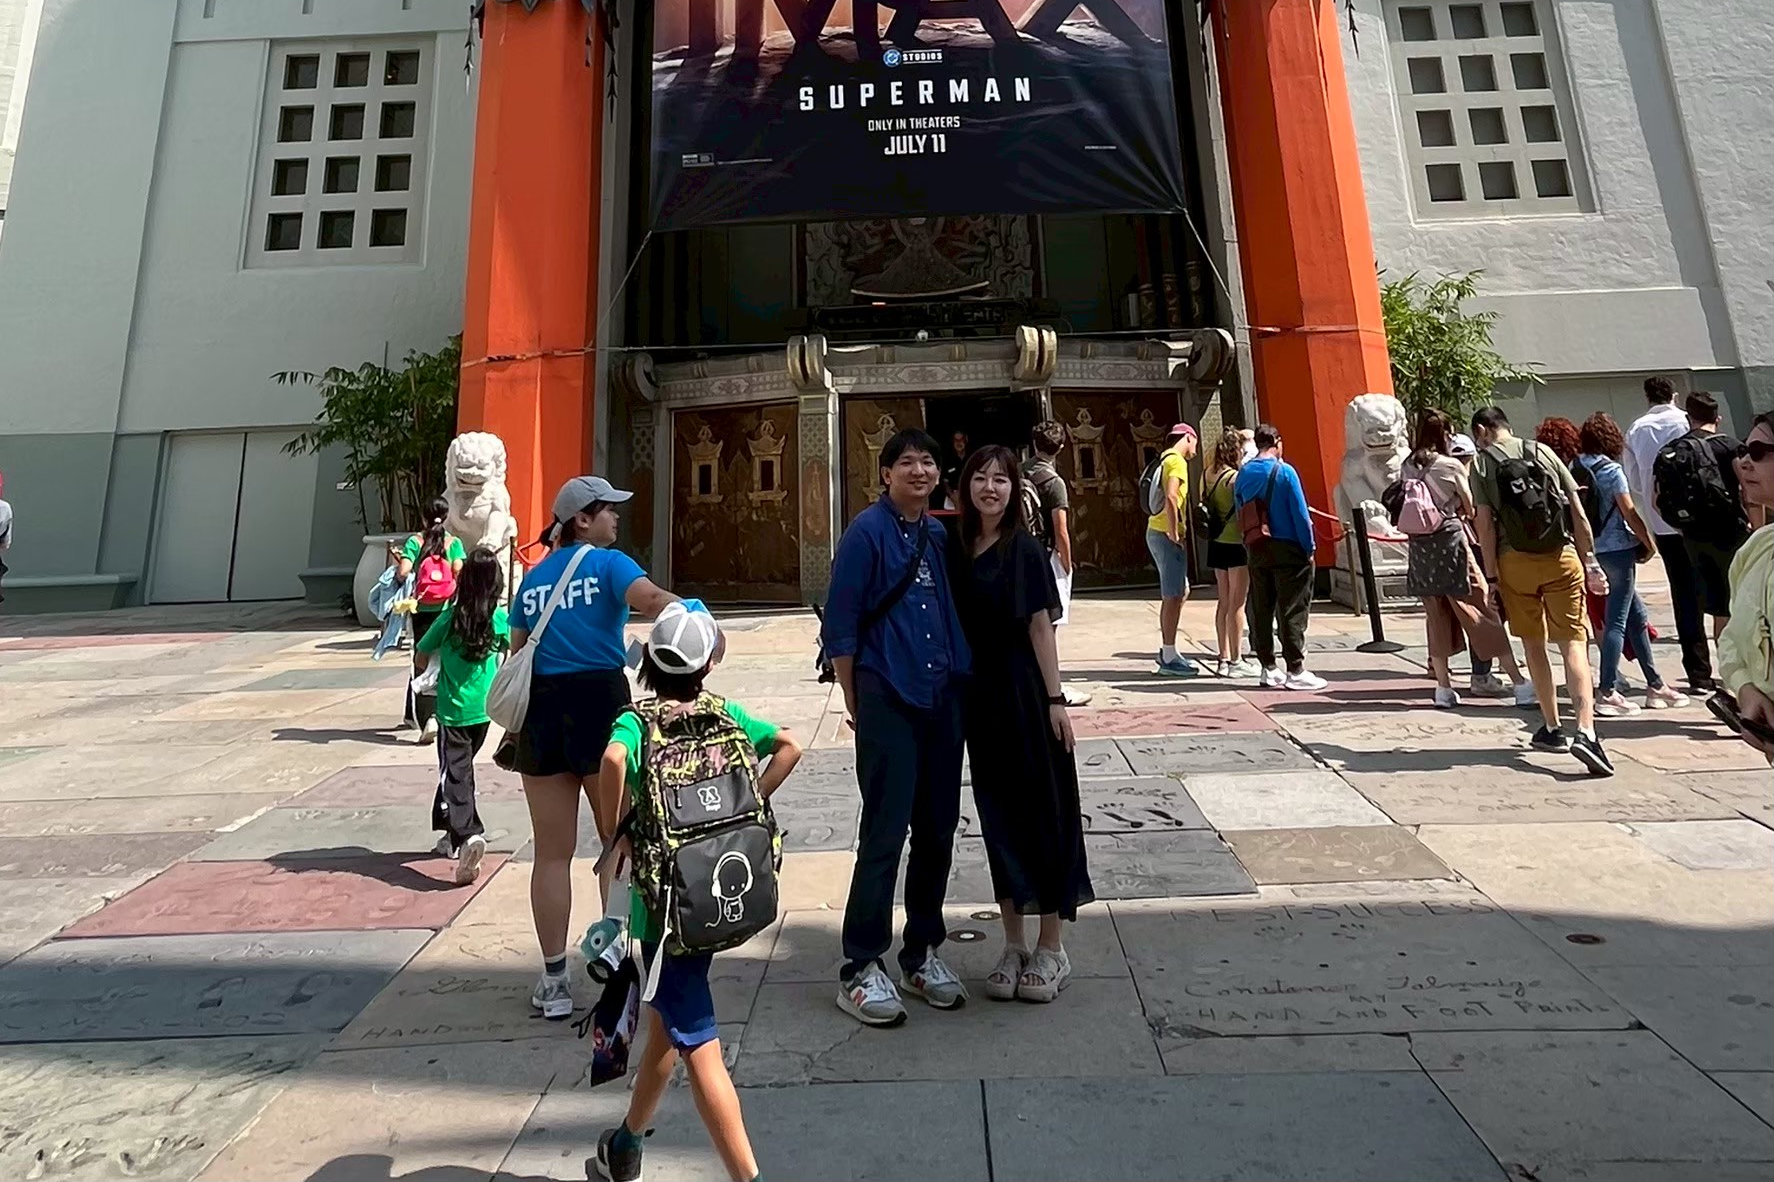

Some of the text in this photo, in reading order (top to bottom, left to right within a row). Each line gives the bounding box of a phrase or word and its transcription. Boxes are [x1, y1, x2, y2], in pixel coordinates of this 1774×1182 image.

[902, 52, 943, 61] STUDIOS
[799, 77, 1032, 111] SUPERMAN
[868, 116, 961, 132] ONLY IN THEATERS
[884, 133, 947, 155] JULY 11
[1400, 1001, 1494, 1019] FOOT
